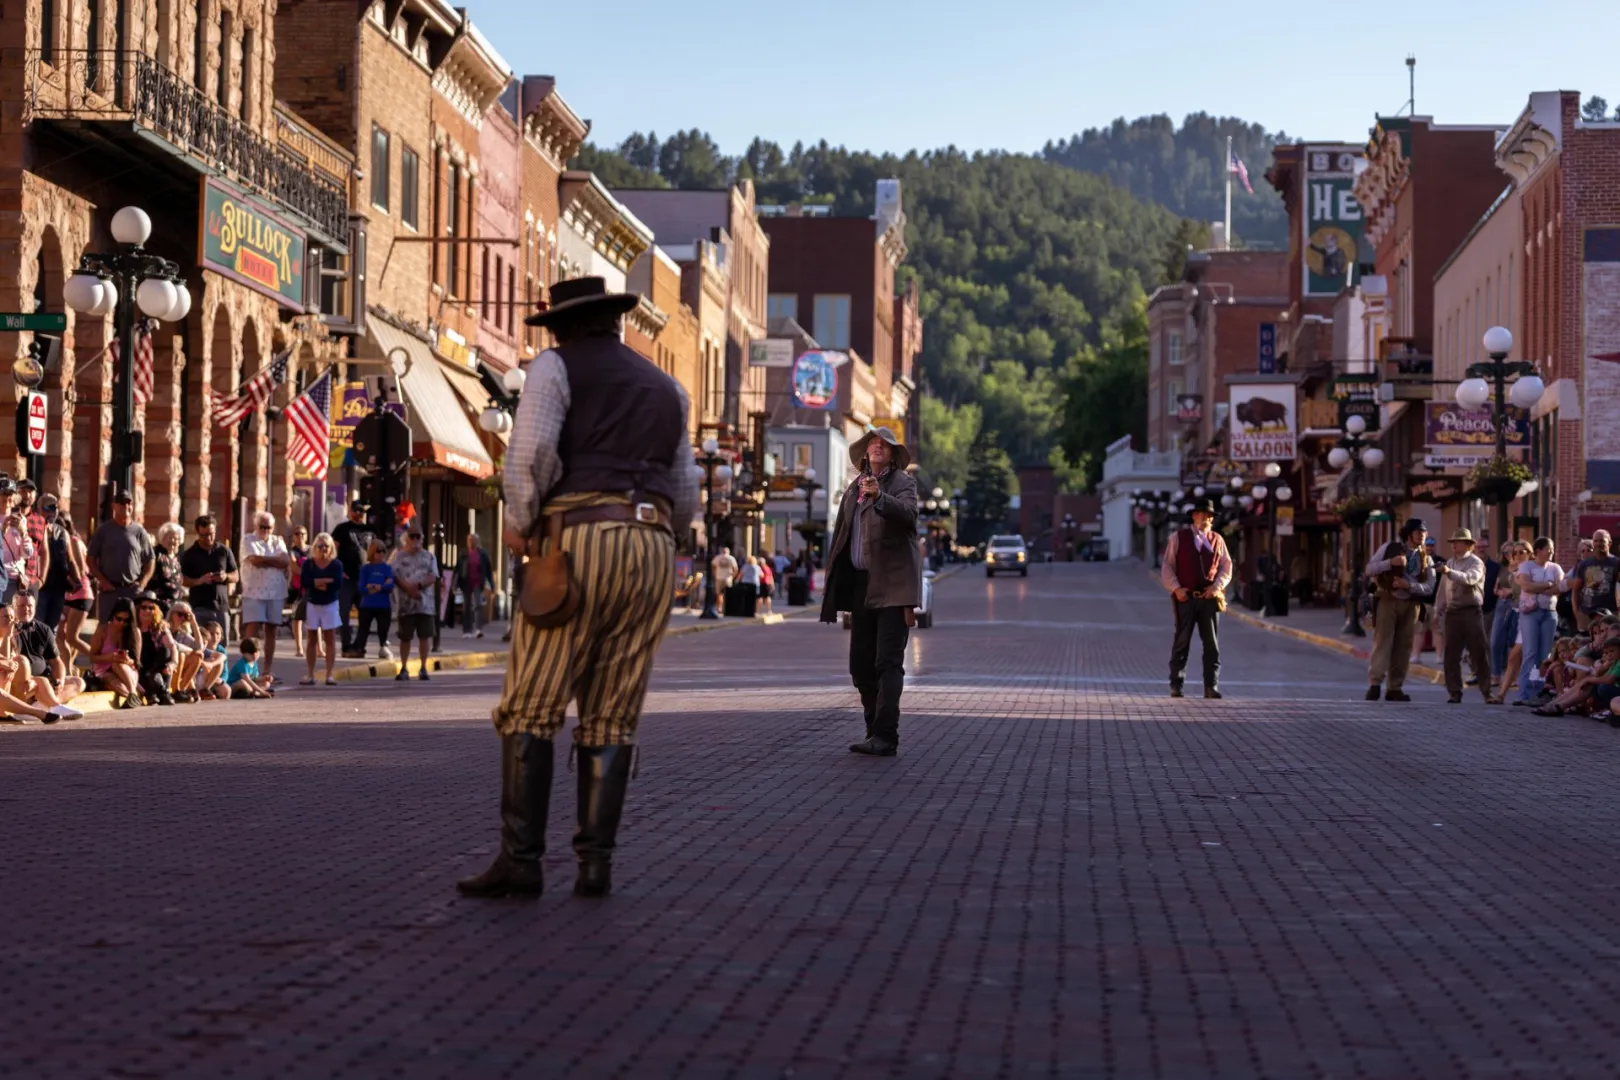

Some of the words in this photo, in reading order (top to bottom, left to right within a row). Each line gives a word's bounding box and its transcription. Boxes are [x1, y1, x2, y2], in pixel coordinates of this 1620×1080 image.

[220, 200, 292, 285] BULLOCK
[5, 315, 25, 328] Wall
[1440, 411, 1517, 433] Peaco's
[31, 429, 42, 441] ENTER
[1233, 441, 1293, 457] SALOON
